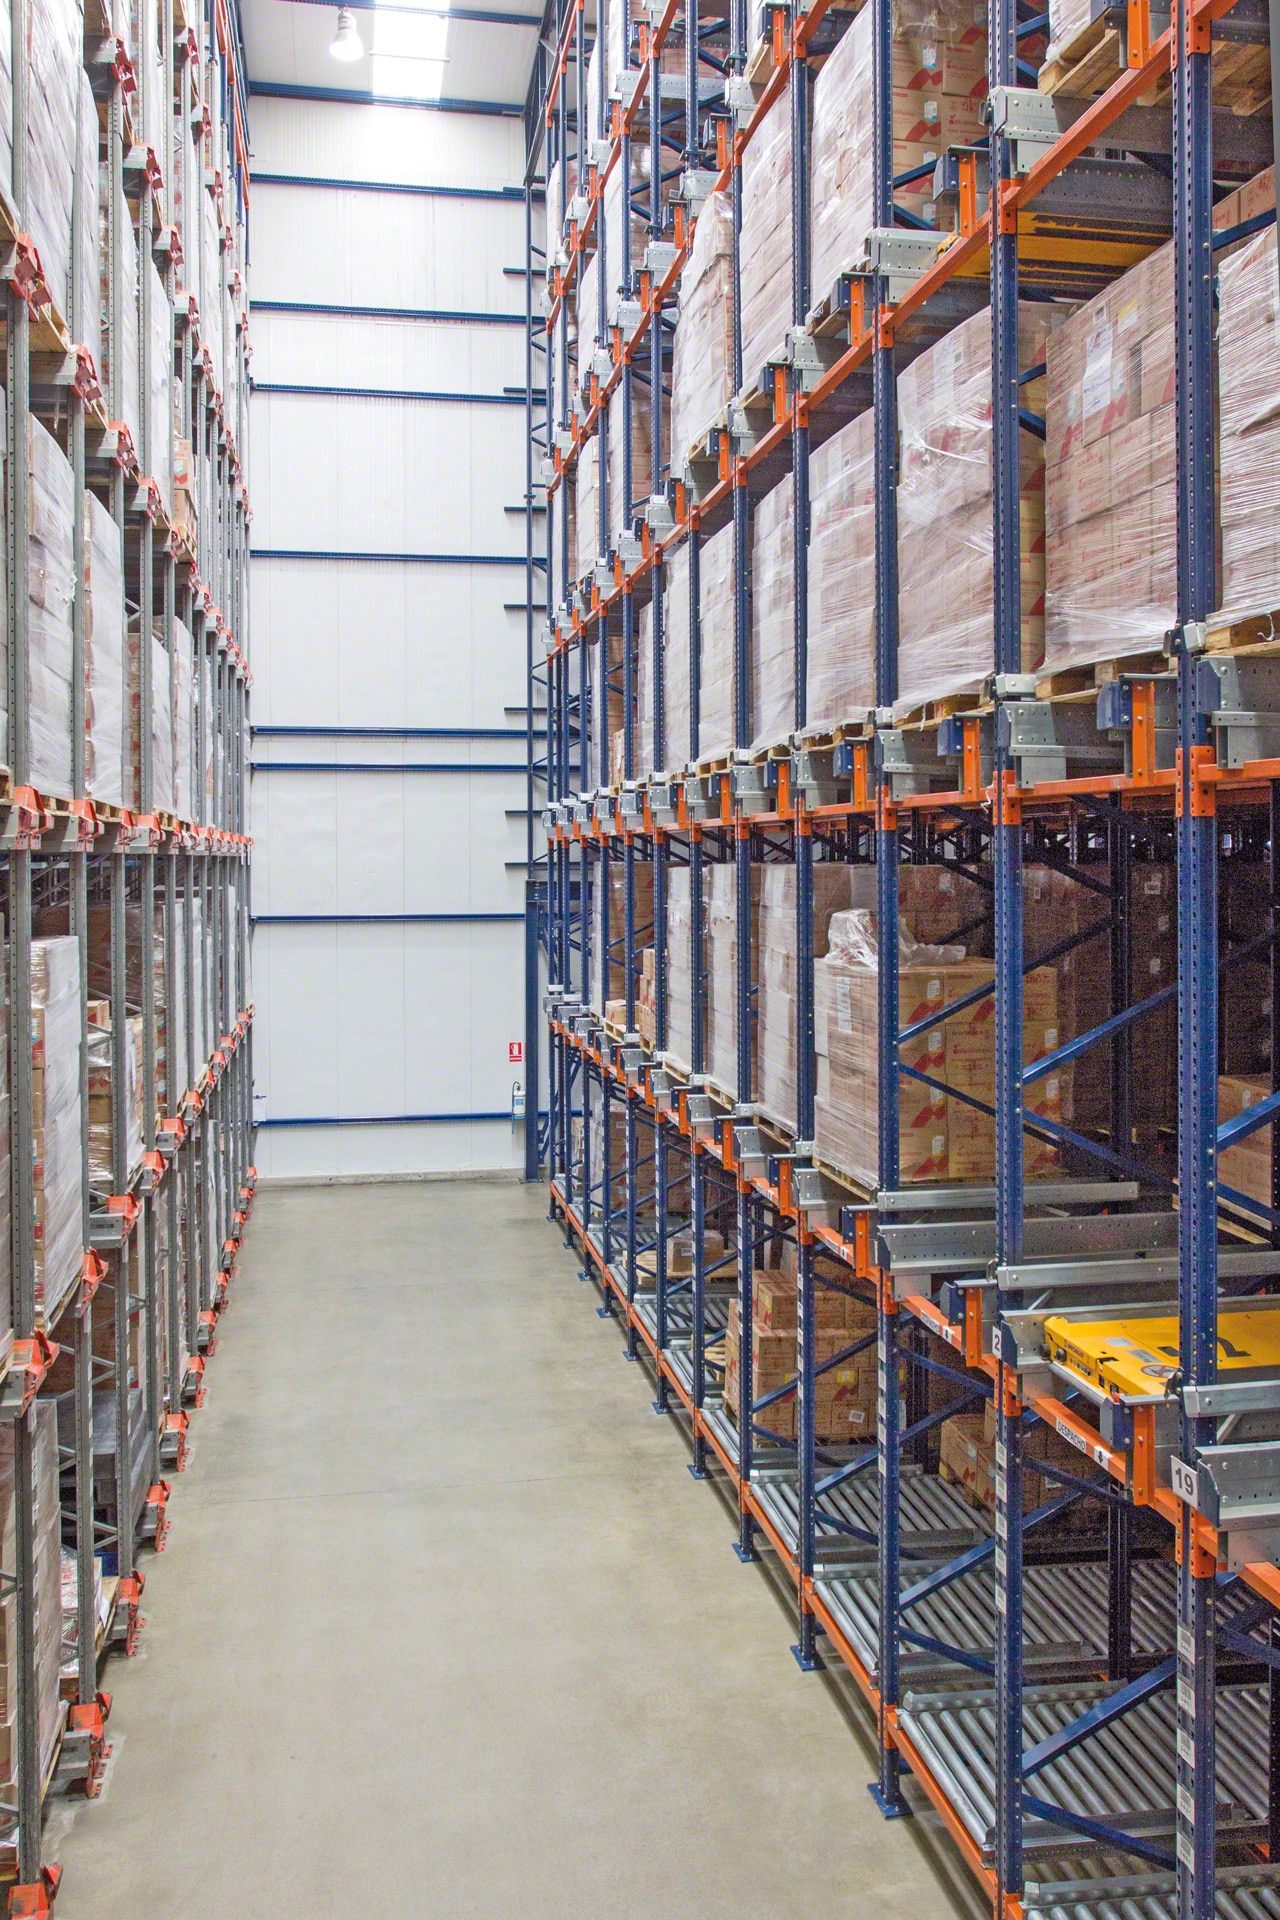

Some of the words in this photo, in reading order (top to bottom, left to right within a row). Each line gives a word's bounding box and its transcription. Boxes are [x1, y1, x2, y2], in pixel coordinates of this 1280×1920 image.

[994, 1334, 1000, 1352] 2
[1057, 1420, 1086, 1451] DESPACHO
[1175, 1467, 1194, 1496] 19
